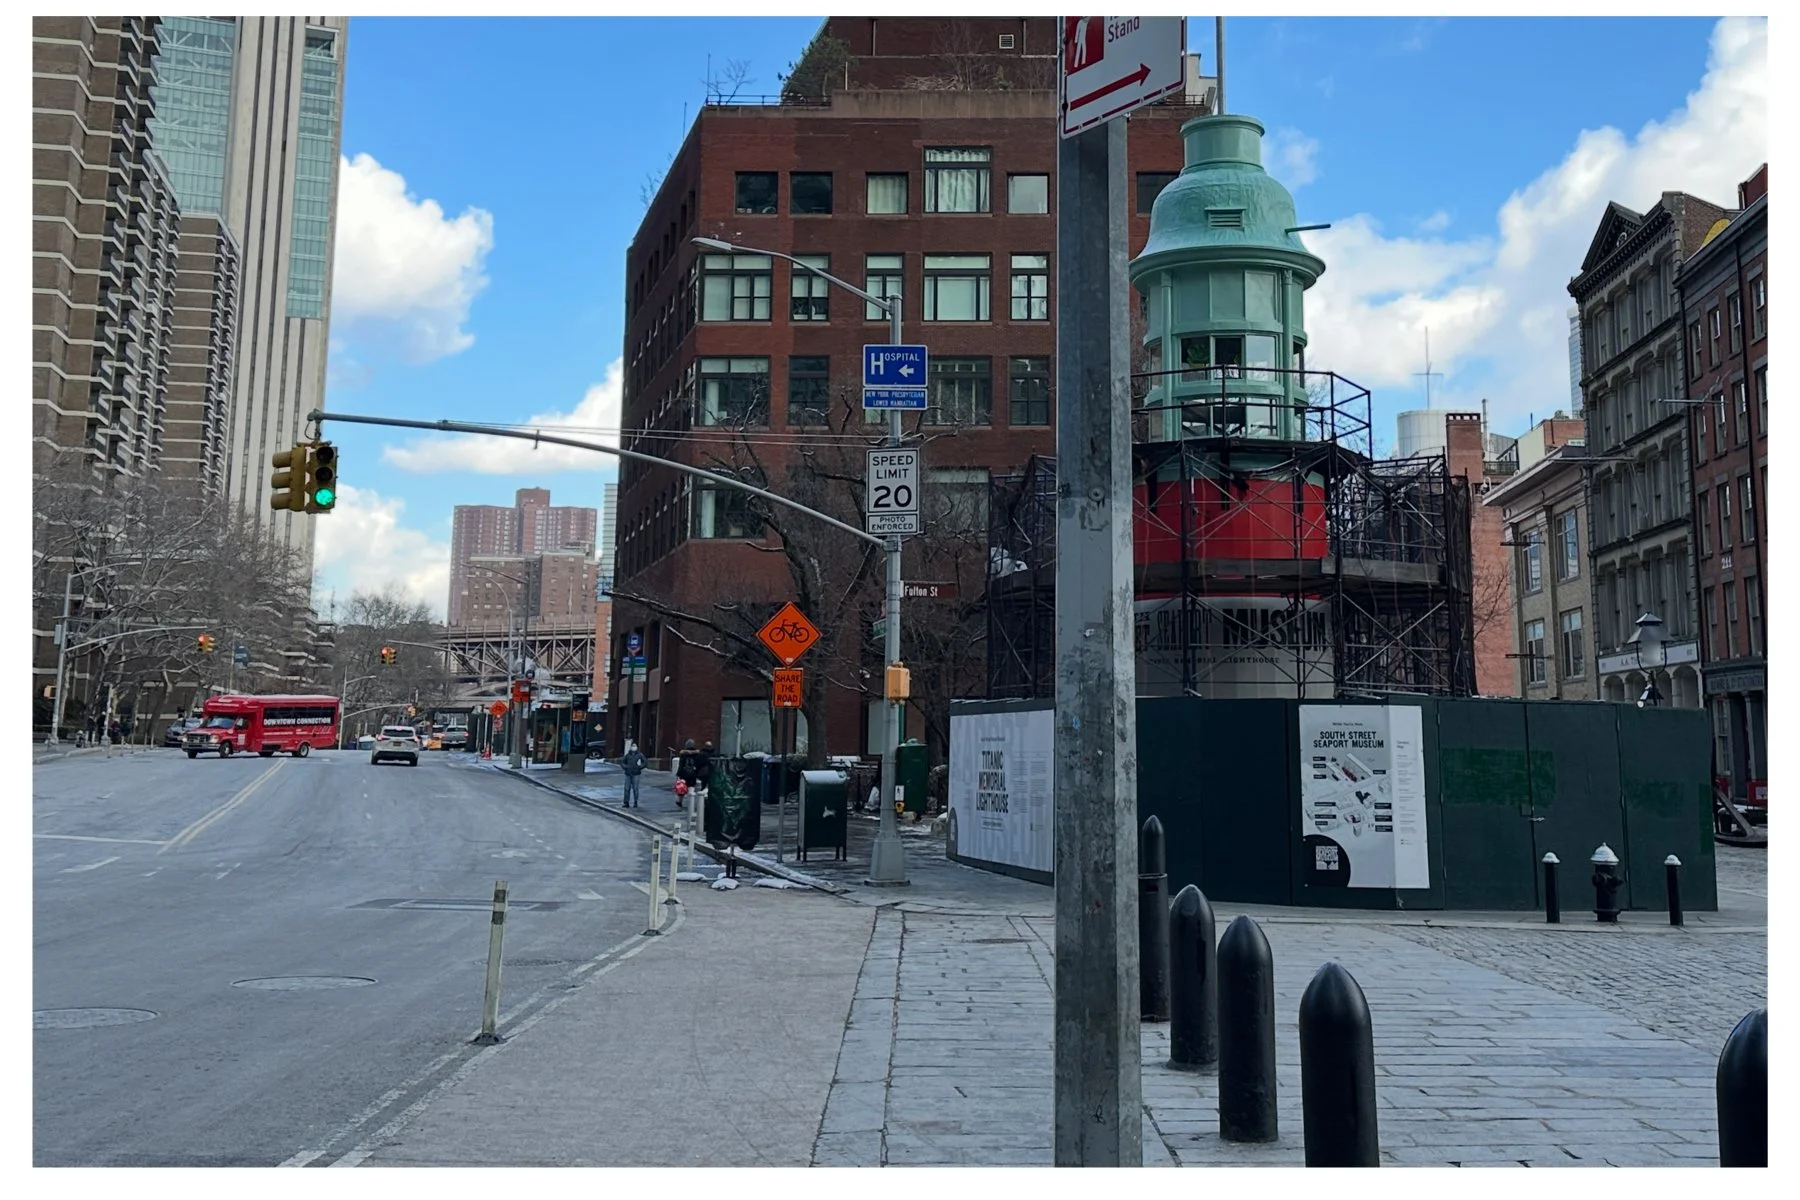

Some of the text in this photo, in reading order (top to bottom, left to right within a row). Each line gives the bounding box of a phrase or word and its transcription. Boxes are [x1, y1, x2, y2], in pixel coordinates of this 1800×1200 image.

[872, 455, 914, 466] SPEED
[876, 468, 909, 480] LIMIT
[873, 484, 912, 508] 20
[871, 522, 914, 531] ENFORCED
[904, 585, 938, 597] Fulton St
[775, 674, 801, 683] SHARE
[781, 684, 795, 693] THE
[777, 694, 798, 702] ROAD
[264, 717, 332, 726] DOWNTOWN CONNECTION
[1320, 731, 1377, 740] SOUTH STREET
[1313, 740, 1384, 749] SEAPORT MUSEUM
[982, 750, 1004, 771] TITANIC
[978, 771, 1007, 792] MEMORIAL
[976, 792, 1009, 814] LIGHTHOUSE
